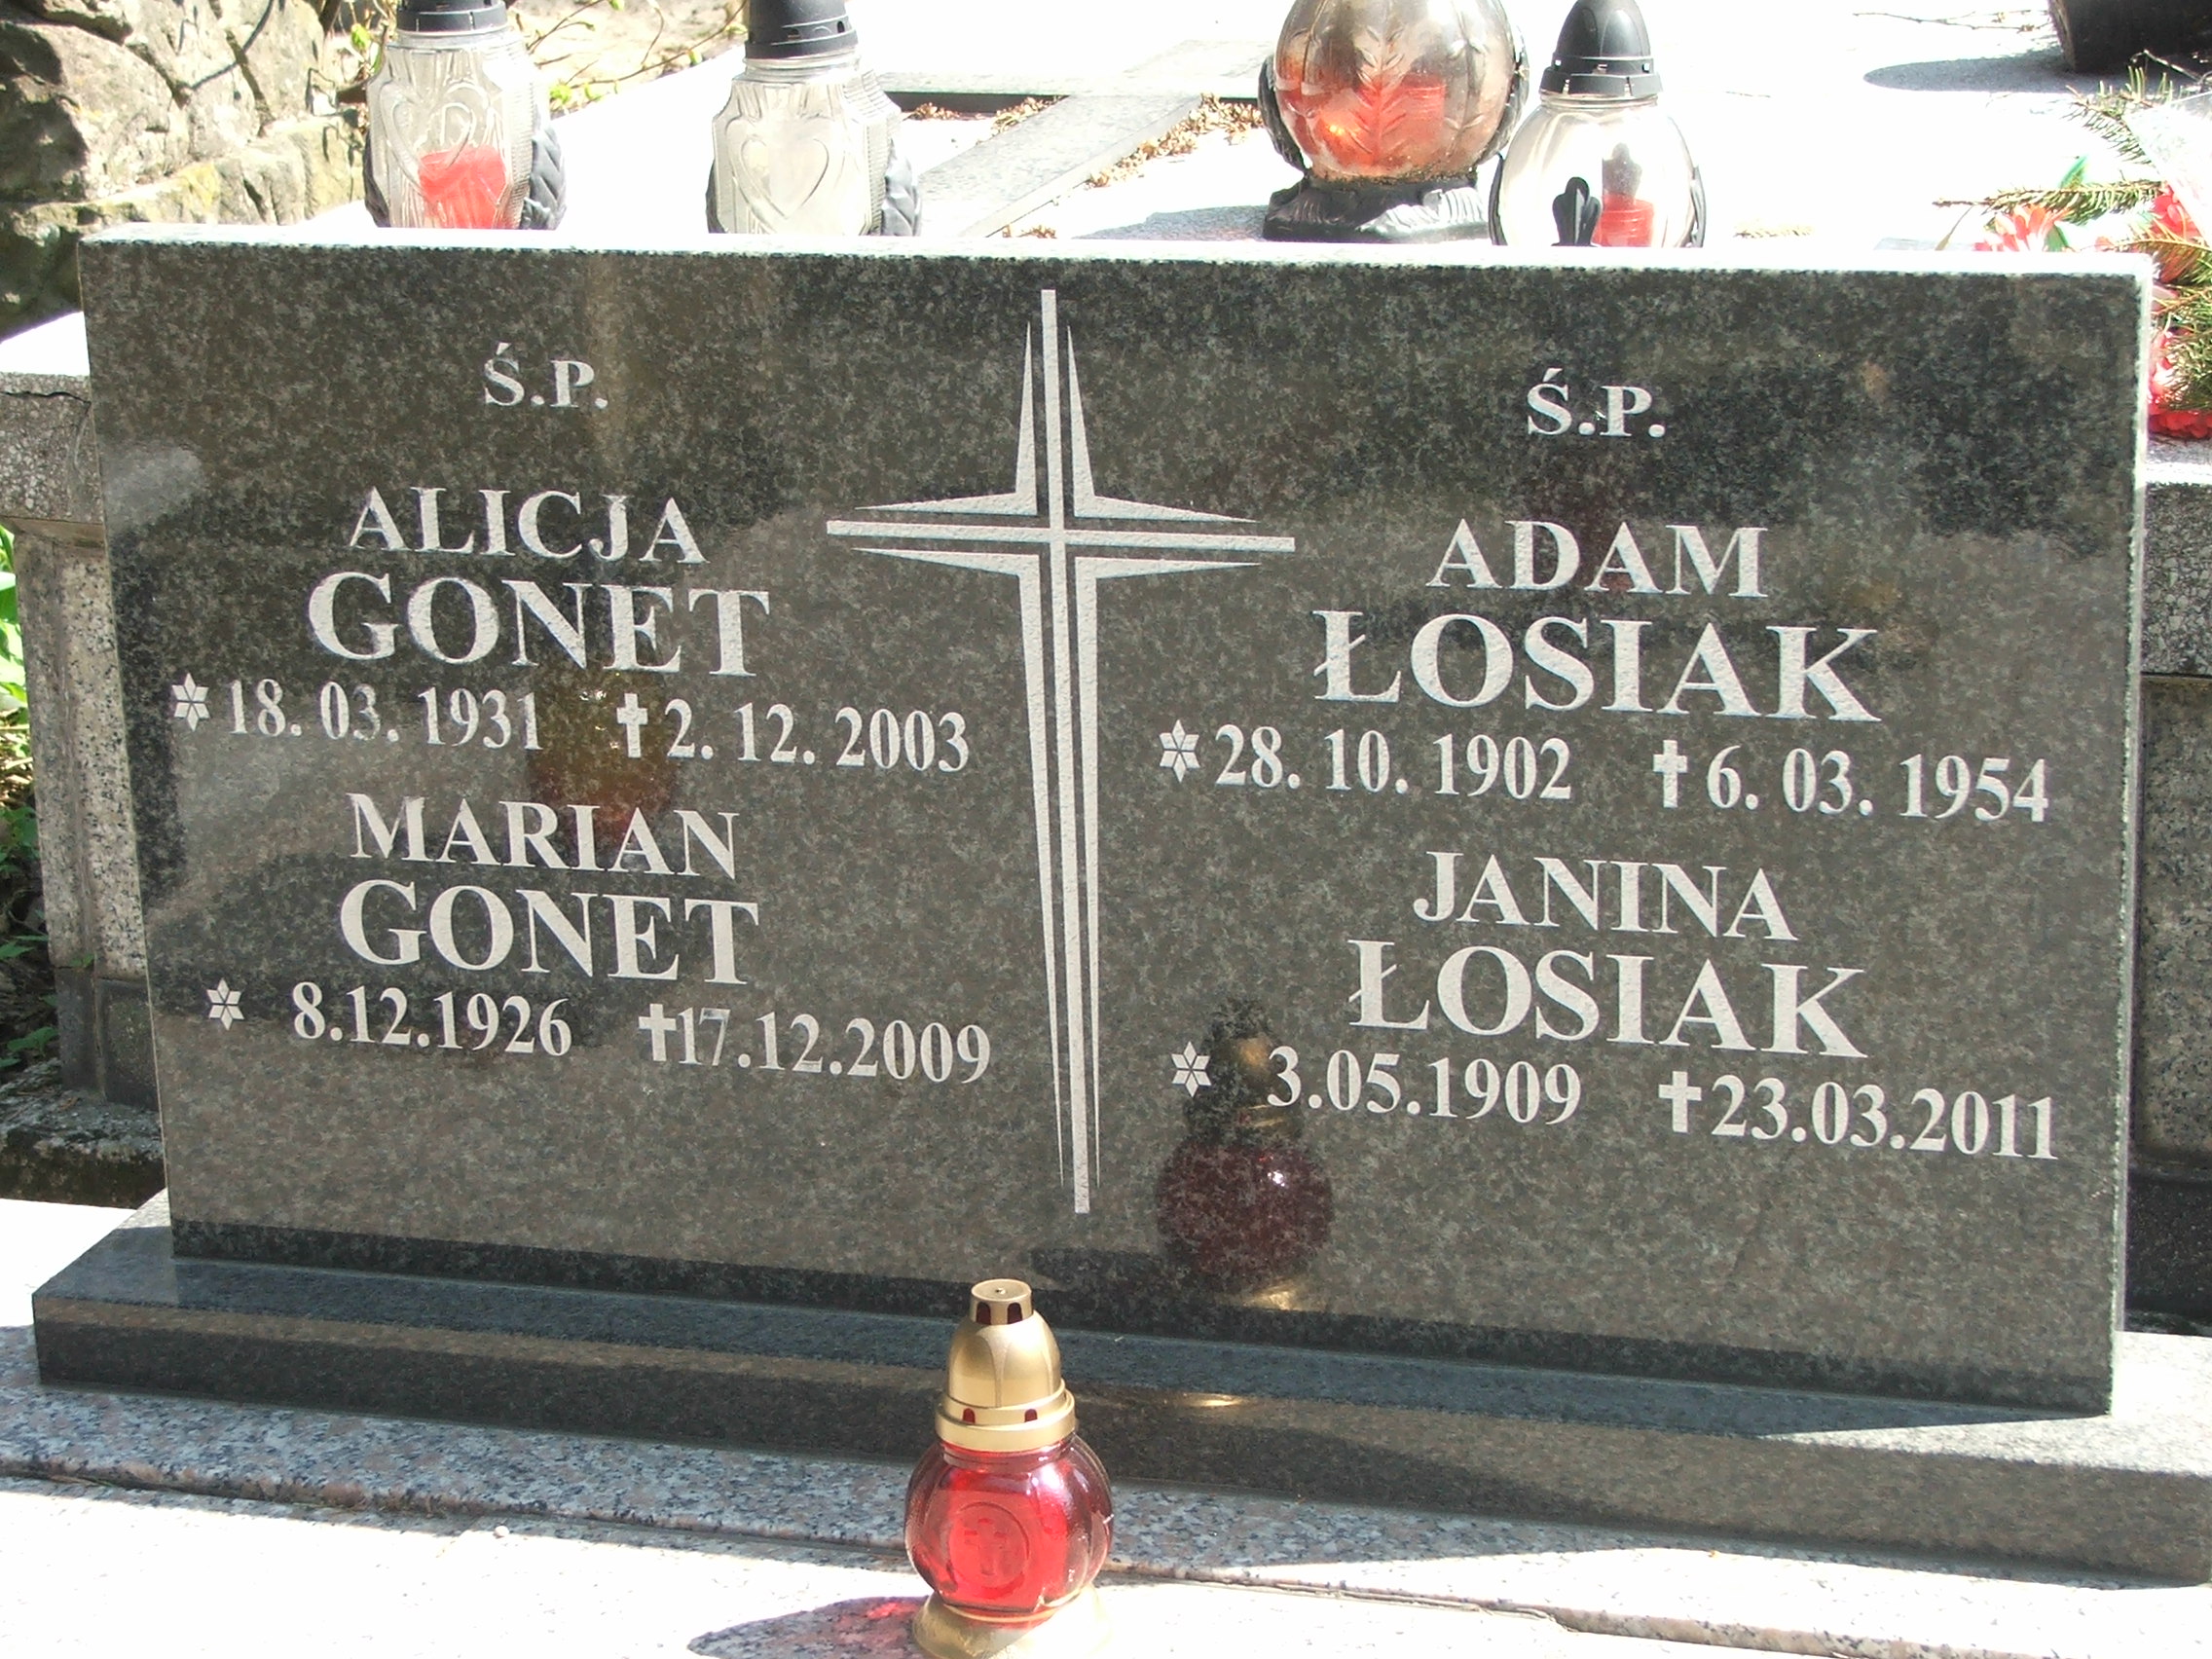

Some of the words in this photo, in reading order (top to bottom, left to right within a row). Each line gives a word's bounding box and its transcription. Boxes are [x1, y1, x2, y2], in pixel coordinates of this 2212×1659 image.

[484, 342, 608, 409] Ś.P.
[1528, 367, 1666, 438] Ś.P.
[350, 486, 710, 565] ALICJA
[1425, 518, 1768, 598] ADAM
[309, 571, 770, 677] GONET
[1311, 609, 1882, 722] ŁOSIAK
[419, 686, 542, 751] 1931
[835, 706, 970, 773] 2003
[1433, 733, 1572, 800] 1902
[1899, 754, 2049, 823] 1954
[346, 793, 739, 880] MARIAN
[340, 879, 759, 985] GONET
[1414, 850, 1799, 941] JANINA
[292, 981, 572, 1056] 8.12.1926
[679, 1007, 991, 1086] 17.12.2009
[1347, 939, 1869, 1059] ŁOSIAK
[1268, 1046, 1581, 1125] 3.05.1909
[1711, 1074, 2059, 1161] 23.03.2011
